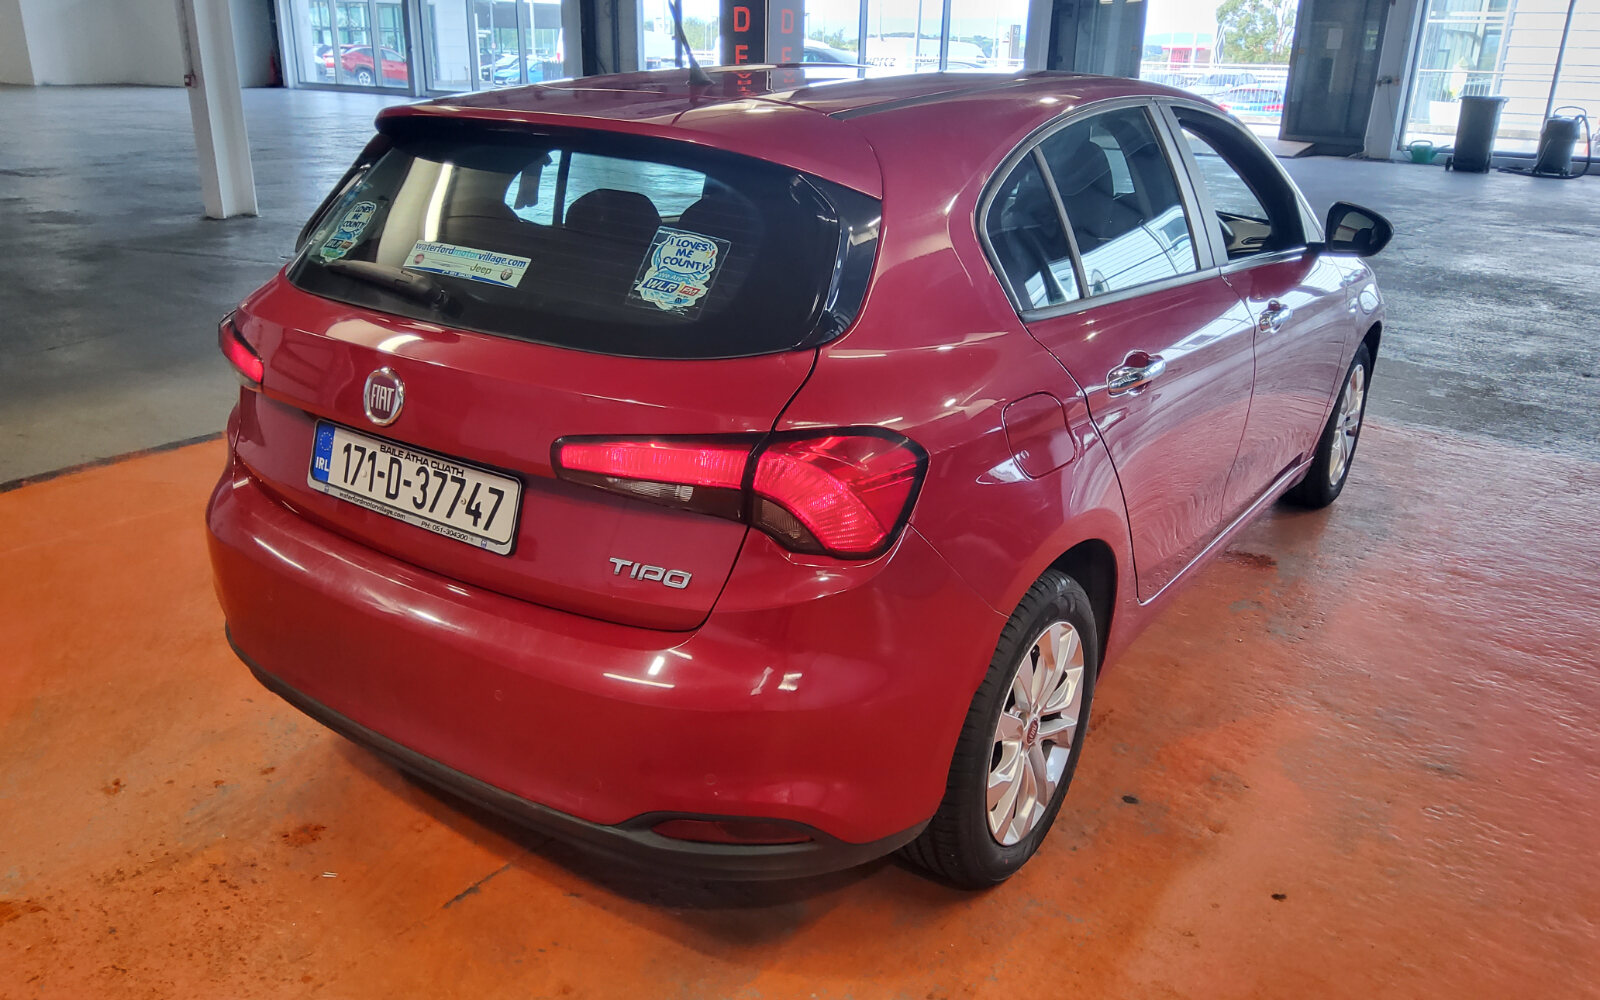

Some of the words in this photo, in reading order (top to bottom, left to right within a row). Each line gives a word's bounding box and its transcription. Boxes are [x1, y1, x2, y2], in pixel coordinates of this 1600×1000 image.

[675, 248, 695, 259] ME
[676, 238, 709, 252] LOVES
[415, 242, 527, 268] waterfordmotorvillage.com
[662, 256, 710, 272] COUNTY
[470, 263, 492, 276] Jeep
[646, 280, 677, 292] WLR
[371, 383, 395, 412] FIAT
[315, 456, 330, 472] IRL
[379, 444, 405, 458] BAILE
[430, 460, 465, 478] CLIATH
[343, 442, 506, 532] 171-D-37747
[339, 490, 406, 521] waterfordmotorvillage.com
[432, 523, 469, 542] 051-304300
[609, 556, 693, 590] TIPO
